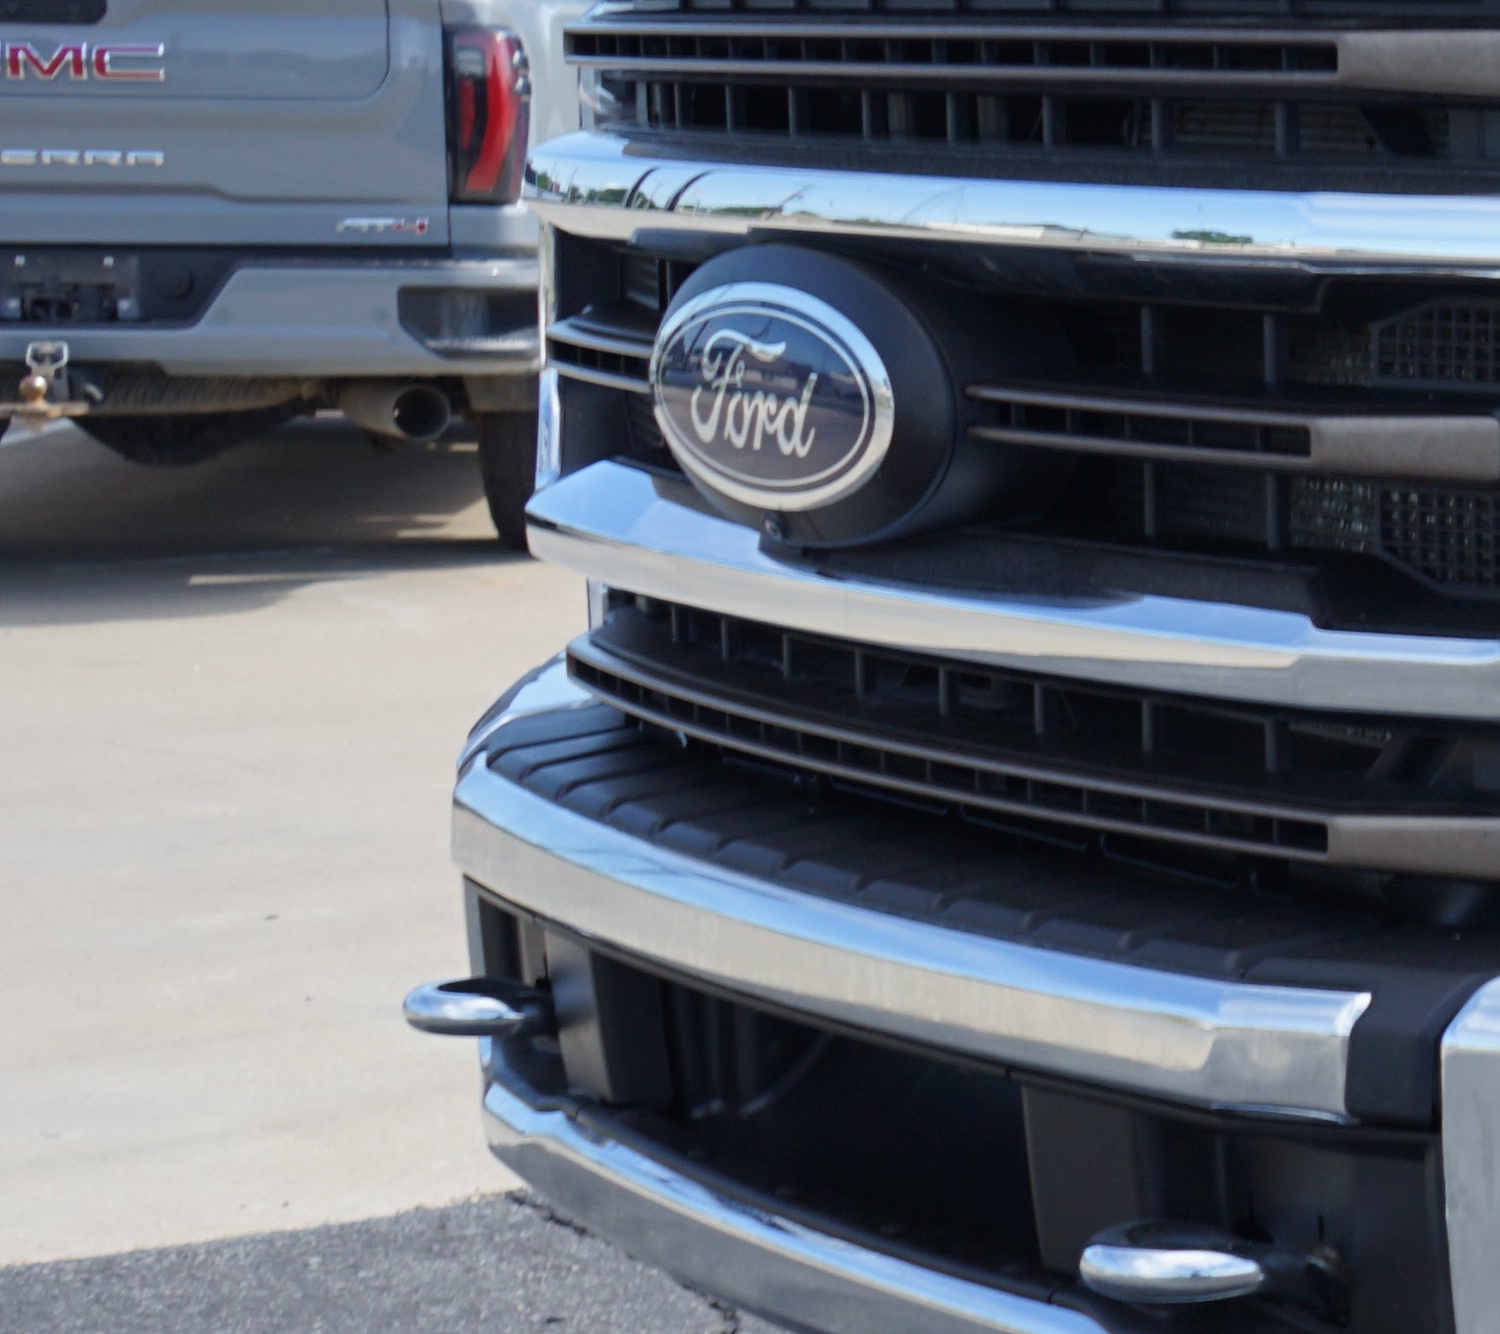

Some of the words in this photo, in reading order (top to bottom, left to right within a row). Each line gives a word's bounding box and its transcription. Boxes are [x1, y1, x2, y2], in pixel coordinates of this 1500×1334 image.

[0, 41, 165, 81] MC
[0, 149, 164, 167] ERRA
[335, 216, 430, 236] AT4
[690, 328, 816, 459] Ford
